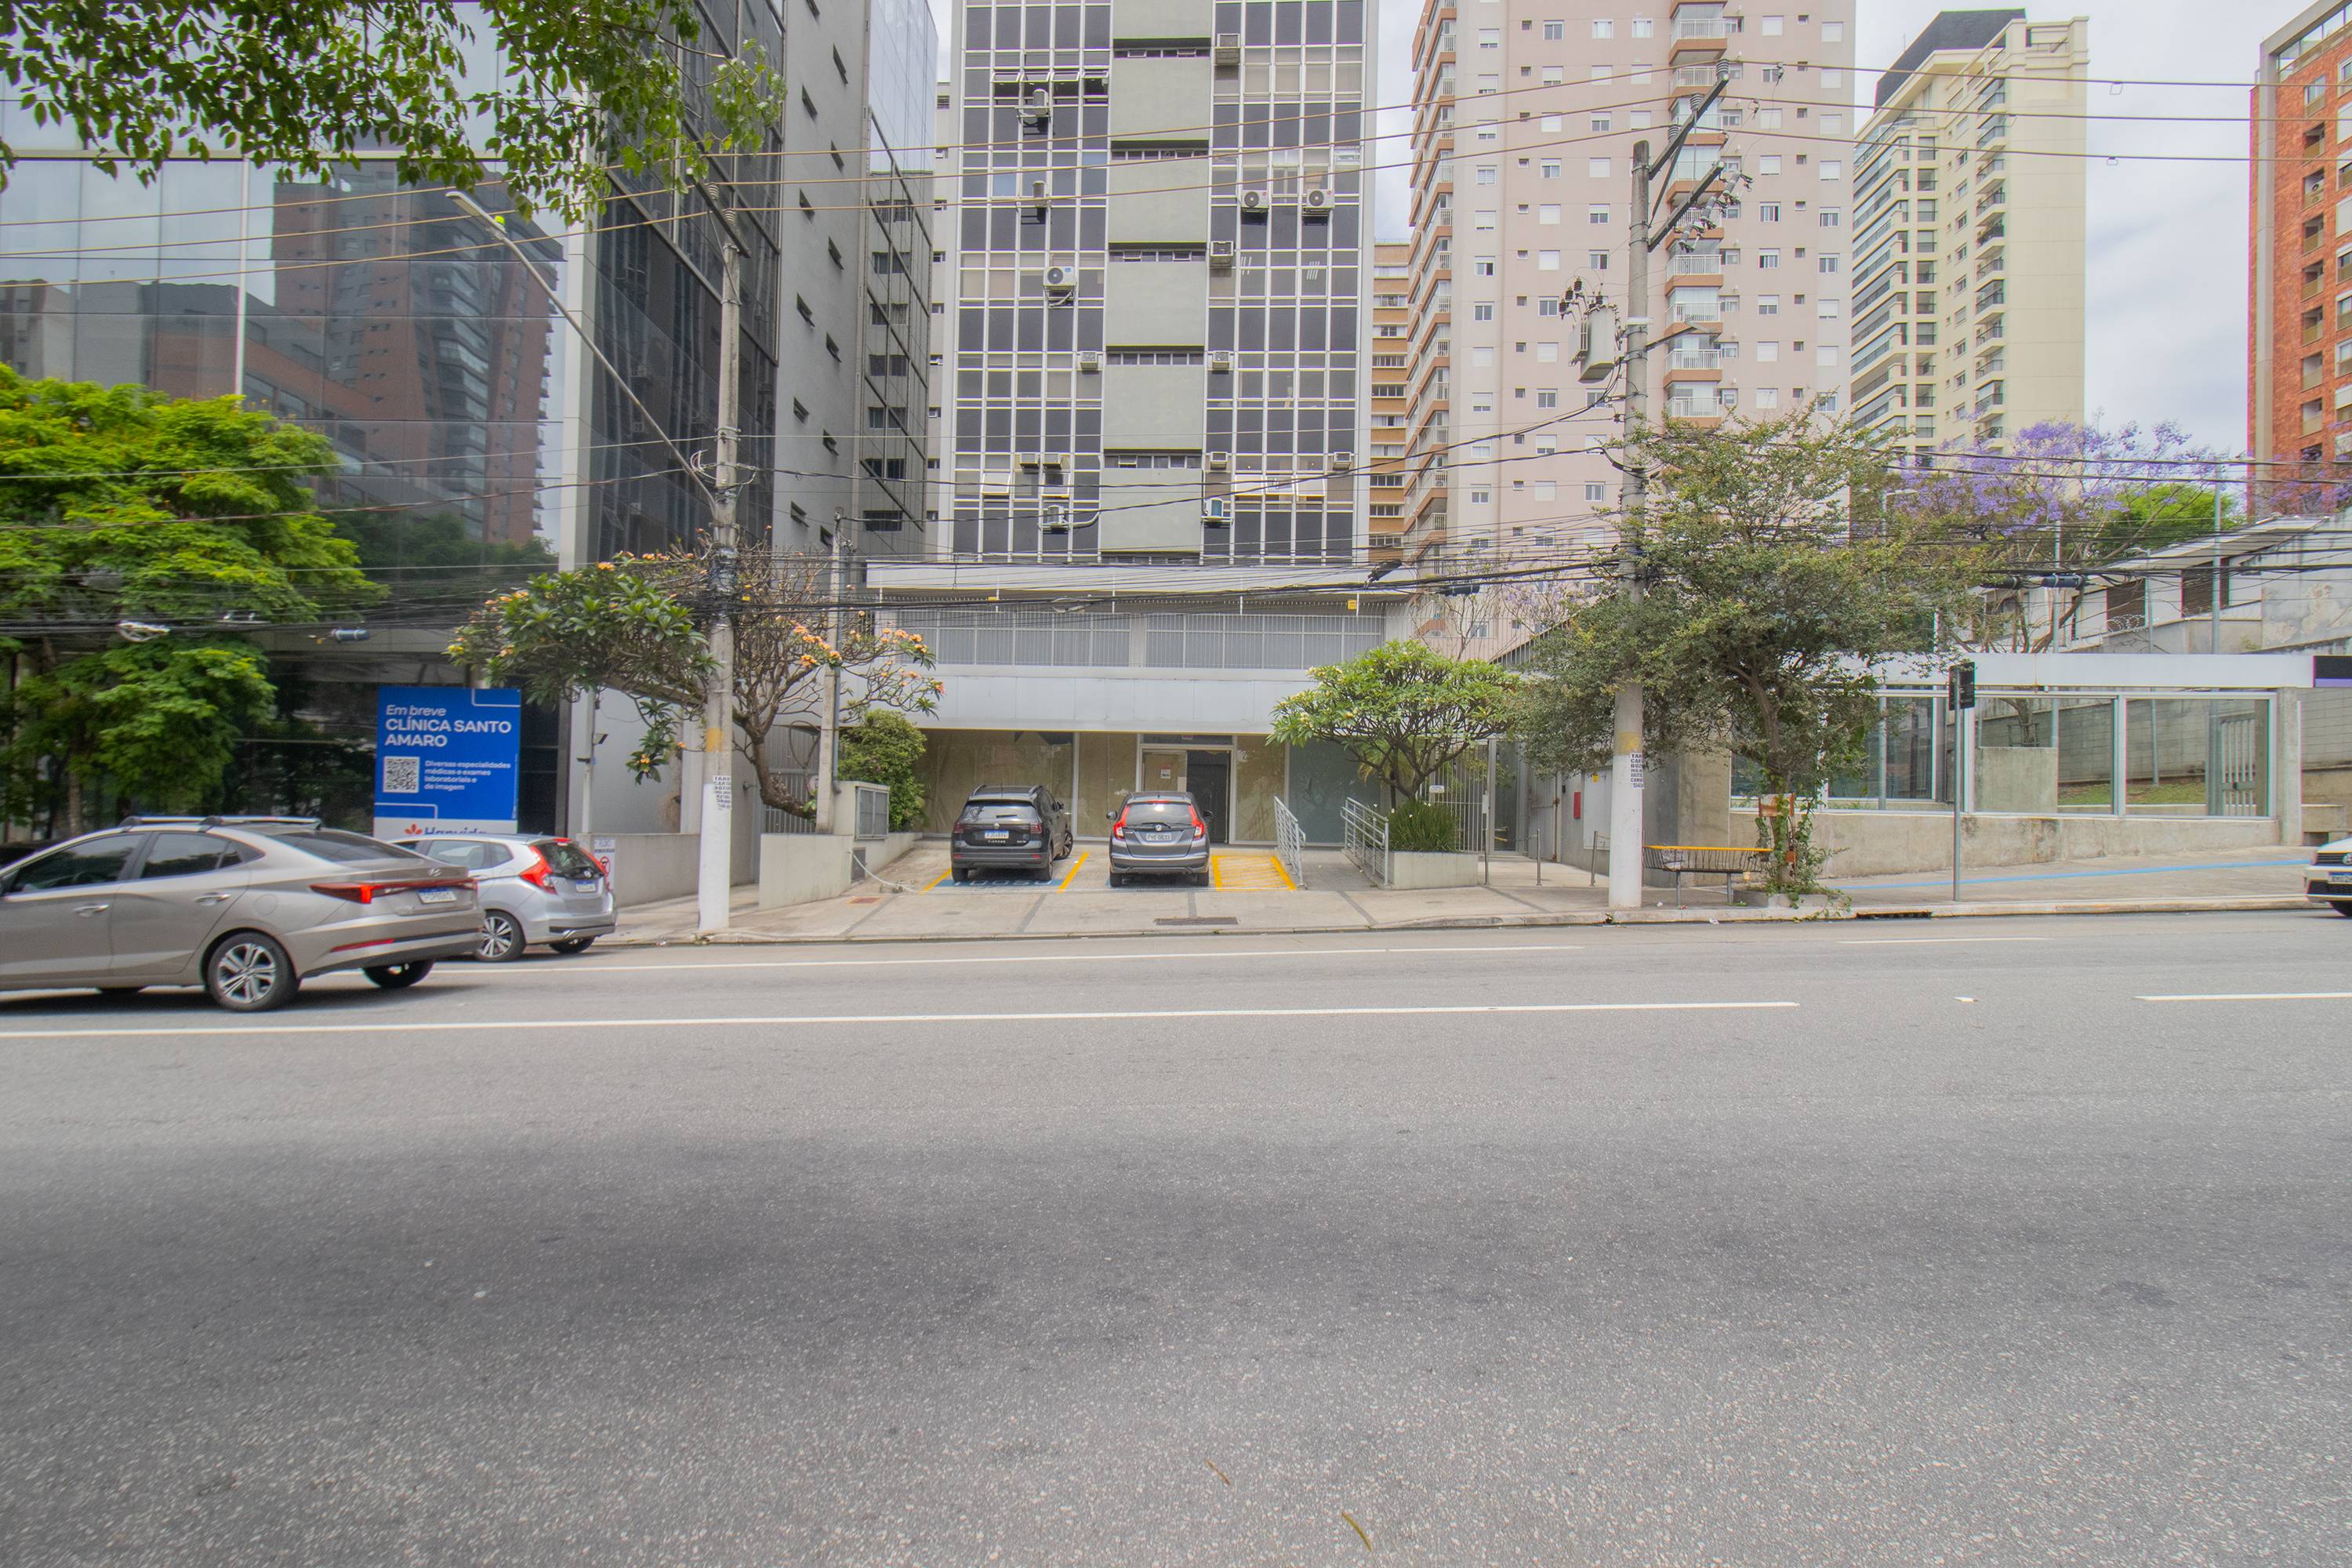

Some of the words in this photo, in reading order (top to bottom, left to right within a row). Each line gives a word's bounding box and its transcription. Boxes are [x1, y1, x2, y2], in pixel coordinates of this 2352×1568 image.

[385, 705, 407, 716] Em
[409, 706, 447, 717] breve
[385, 716, 452, 732] CLÍNICA
[453, 720, 512, 734] SANTO
[384, 734, 448, 747] AMARO
[434, 783, 465, 792] imagem
